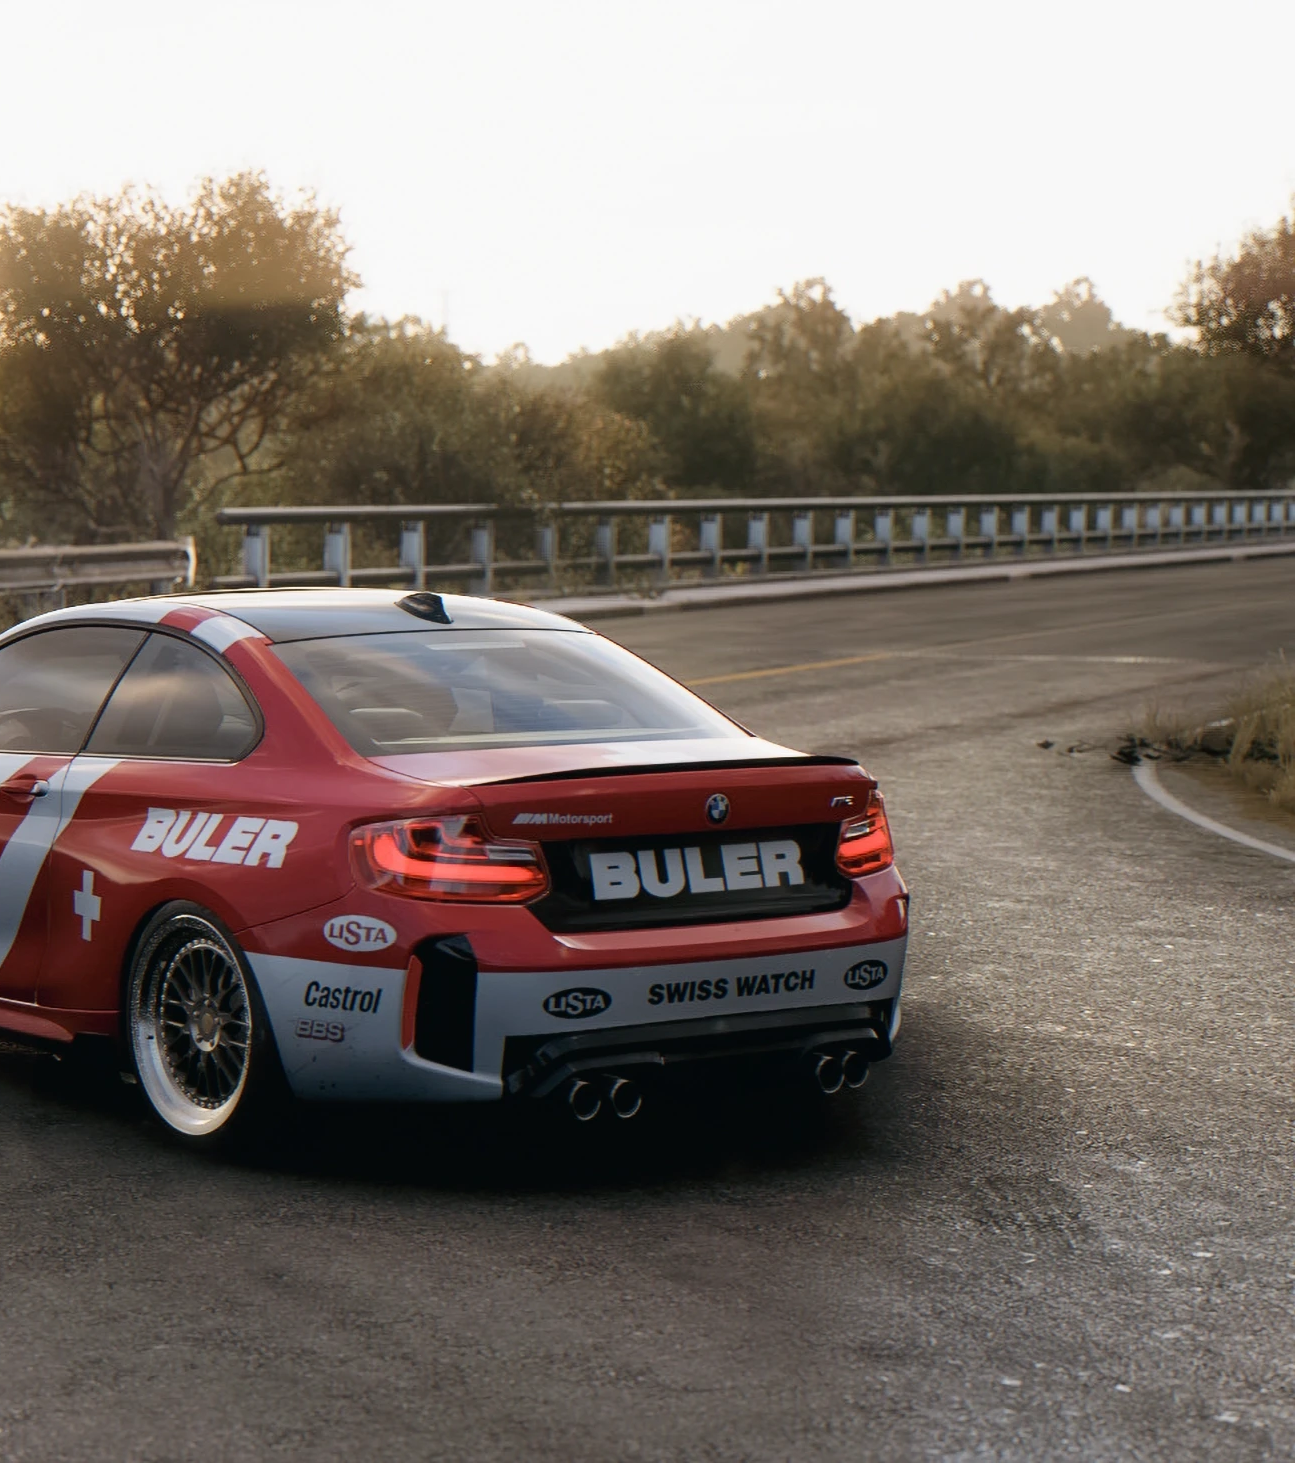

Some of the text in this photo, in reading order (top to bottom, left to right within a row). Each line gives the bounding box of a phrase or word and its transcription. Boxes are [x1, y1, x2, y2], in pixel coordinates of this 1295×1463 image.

[549, 813, 613, 826] Motorsport
[130, 807, 299, 868] BULER
[589, 840, 804, 900] BULER
[328, 921, 389, 946] LISTA
[648, 969, 815, 1005] SWISS WATCH
[847, 964, 885, 986] LISTA
[305, 981, 383, 1014] Castrol
[548, 992, 606, 1015] LISTA
[295, 1018, 345, 1043] BBS
